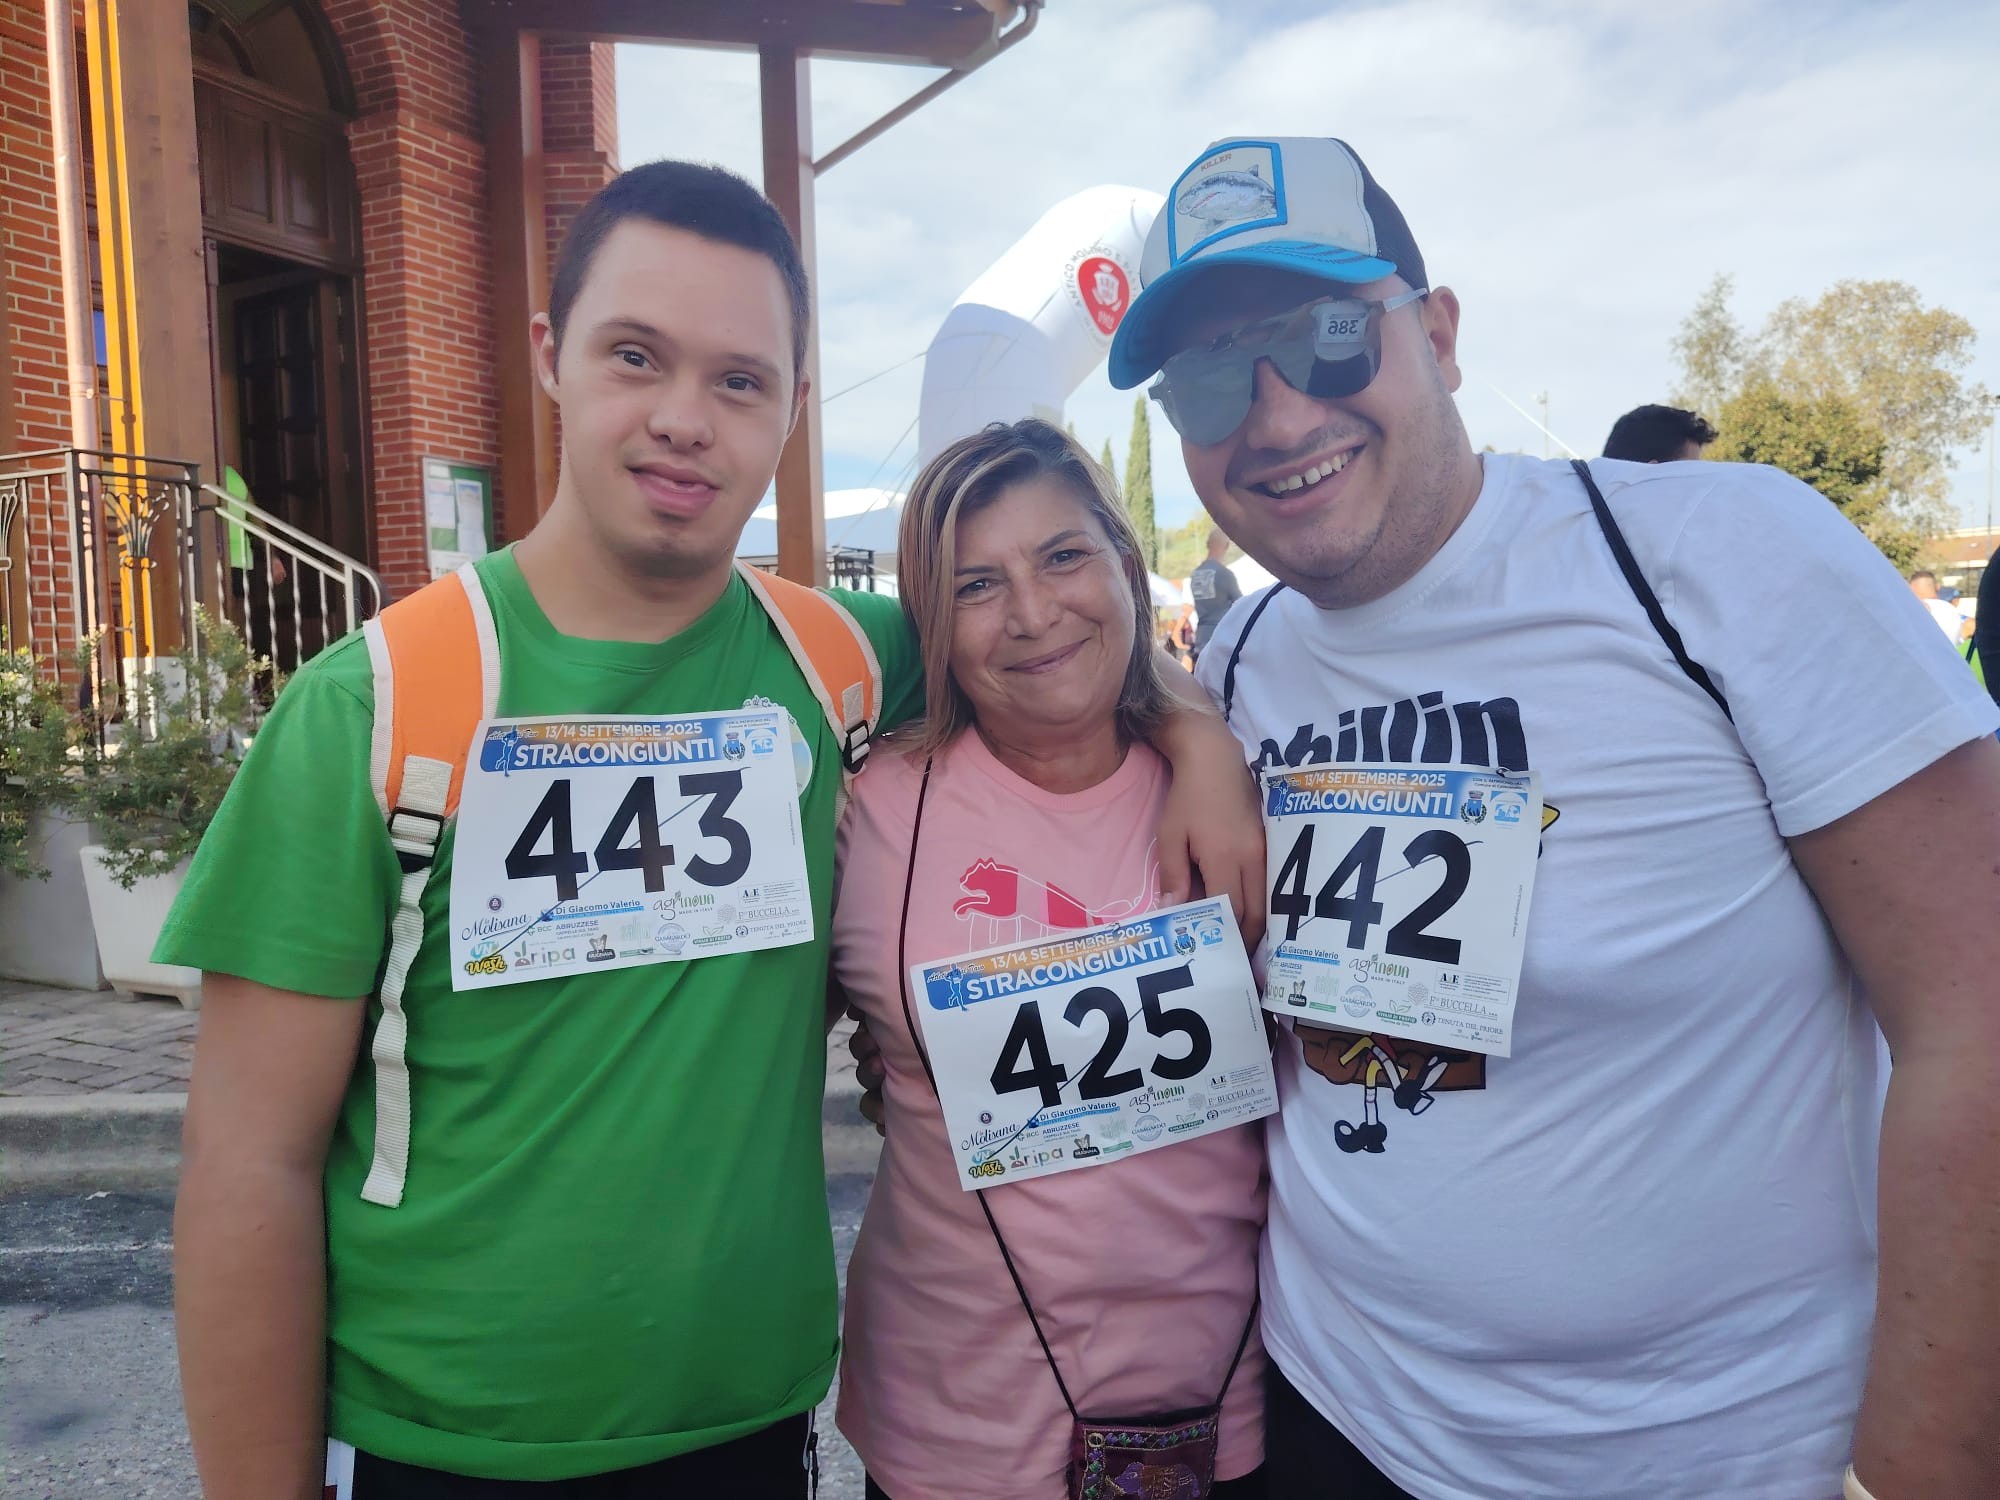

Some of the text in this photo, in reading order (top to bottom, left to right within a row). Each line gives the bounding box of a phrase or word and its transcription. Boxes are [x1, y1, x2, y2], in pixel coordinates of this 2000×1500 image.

[1201, 152, 1232, 171] KILLER
[545, 724, 576, 741] 13/14
[579, 723, 661, 738] SETTEMBRE
[665, 722, 703, 737] 2025
[514, 738, 715, 767] STRACONGIUNTI
[1305, 772, 1325, 787] 13/14
[1327, 772, 1407, 785] SETTEMBRE
[1409, 773, 1447, 787] 2025
[1284, 788, 1454, 816] STRACONGIUNTI
[504, 769, 752, 902] 443
[1270, 823, 1471, 965] 442
[555, 906, 566, 915] Di
[568, 903, 609, 914] Giacomo
[610, 899, 641, 909] Valerio
[748, 906, 790, 919] BUCCELLA
[462, 914, 527, 941] Molisana
[555, 919, 599, 930] ABRUZZESE
[990, 951, 1028, 969] 13/14
[1031, 932, 1116, 960] SETTEMBRE
[1118, 922, 1153, 941] 2025
[1288, 946, 1313, 956] Giacomo
[1314, 949, 1339, 959] Valerio
[465, 955, 508, 975] Wash
[530, 946, 576, 967] ripa
[967, 935, 1169, 1000] STRACONGIUNTI
[1440, 997, 1486, 1015] BUCCELLA
[989, 964, 1212, 1108] 425
[1438, 1017, 1503, 1035] TENUTA DEL PRIORE
[1217, 1087, 1256, 1103] BUCCELLA
[1040, 1113, 1049, 1121] Di
[1050, 1106, 1087, 1119] Giacomo
[1087, 1101, 1117, 1111] Valerio
[961, 1123, 1017, 1151] Molisana
[1042, 1122, 1080, 1134] ABRUZZESE
[1024, 1147, 1064, 1167] ripa
[968, 1159, 1006, 1178] Wash
